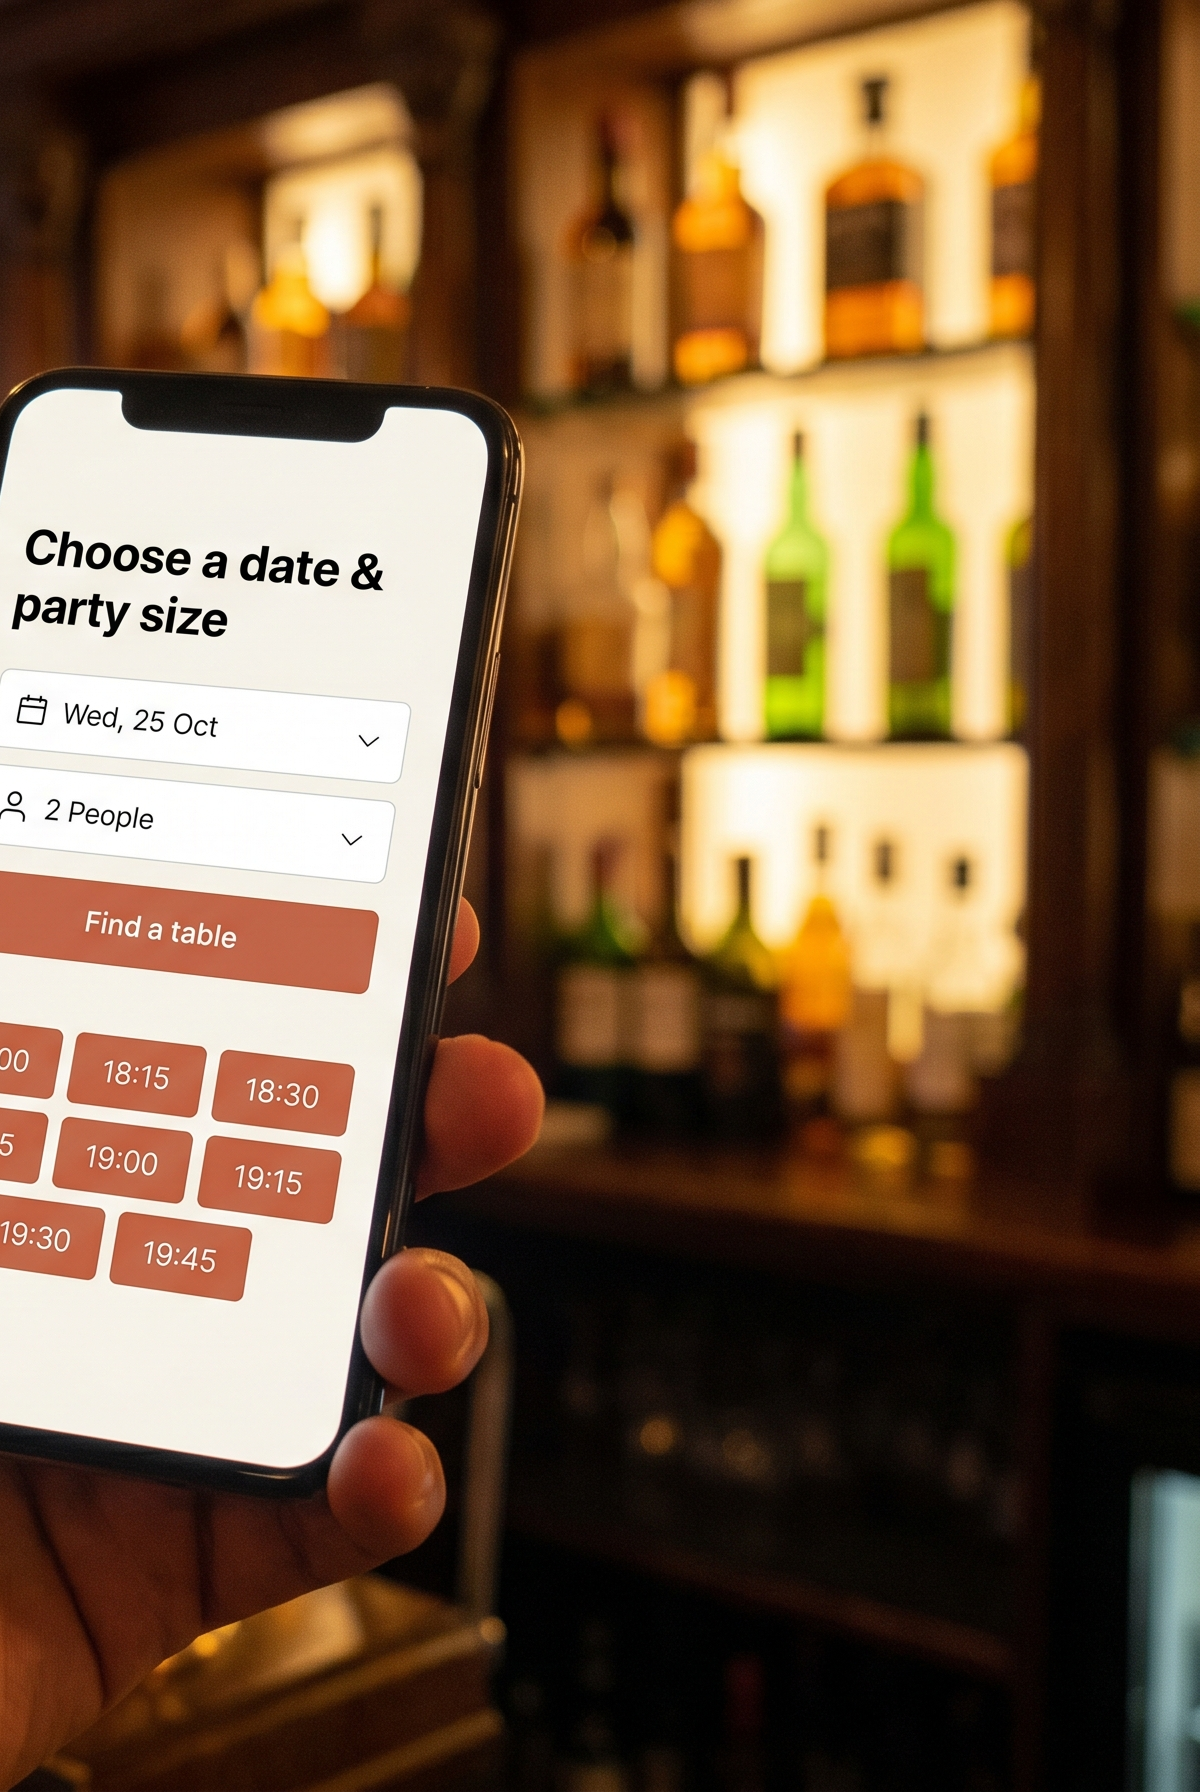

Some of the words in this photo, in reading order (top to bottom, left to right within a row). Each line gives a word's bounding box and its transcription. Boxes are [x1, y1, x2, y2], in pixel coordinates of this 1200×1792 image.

[25, 528, 192, 577] Choose
[201, 550, 228, 580] a
[239, 545, 340, 588] date
[350, 552, 384, 592] &
[11, 593, 132, 638] party
[139, 595, 228, 638] size
[64, 702, 123, 734] Wed,
[132, 708, 166, 733] 25
[173, 712, 219, 738] Oct
[44, 798, 61, 822] 2
[68, 800, 154, 833] People
[84, 910, 142, 938] Find
[147, 922, 163, 941] a
[171, 921, 237, 949] table
[104, 1060, 170, 1090] 18:15
[246, 1078, 319, 1109] 18:30
[86, 1144, 158, 1176] 19:00
[235, 1164, 303, 1195] 19:15
[0, 1220, 71, 1253] 19:30
[144, 1240, 217, 1273] 19:45
